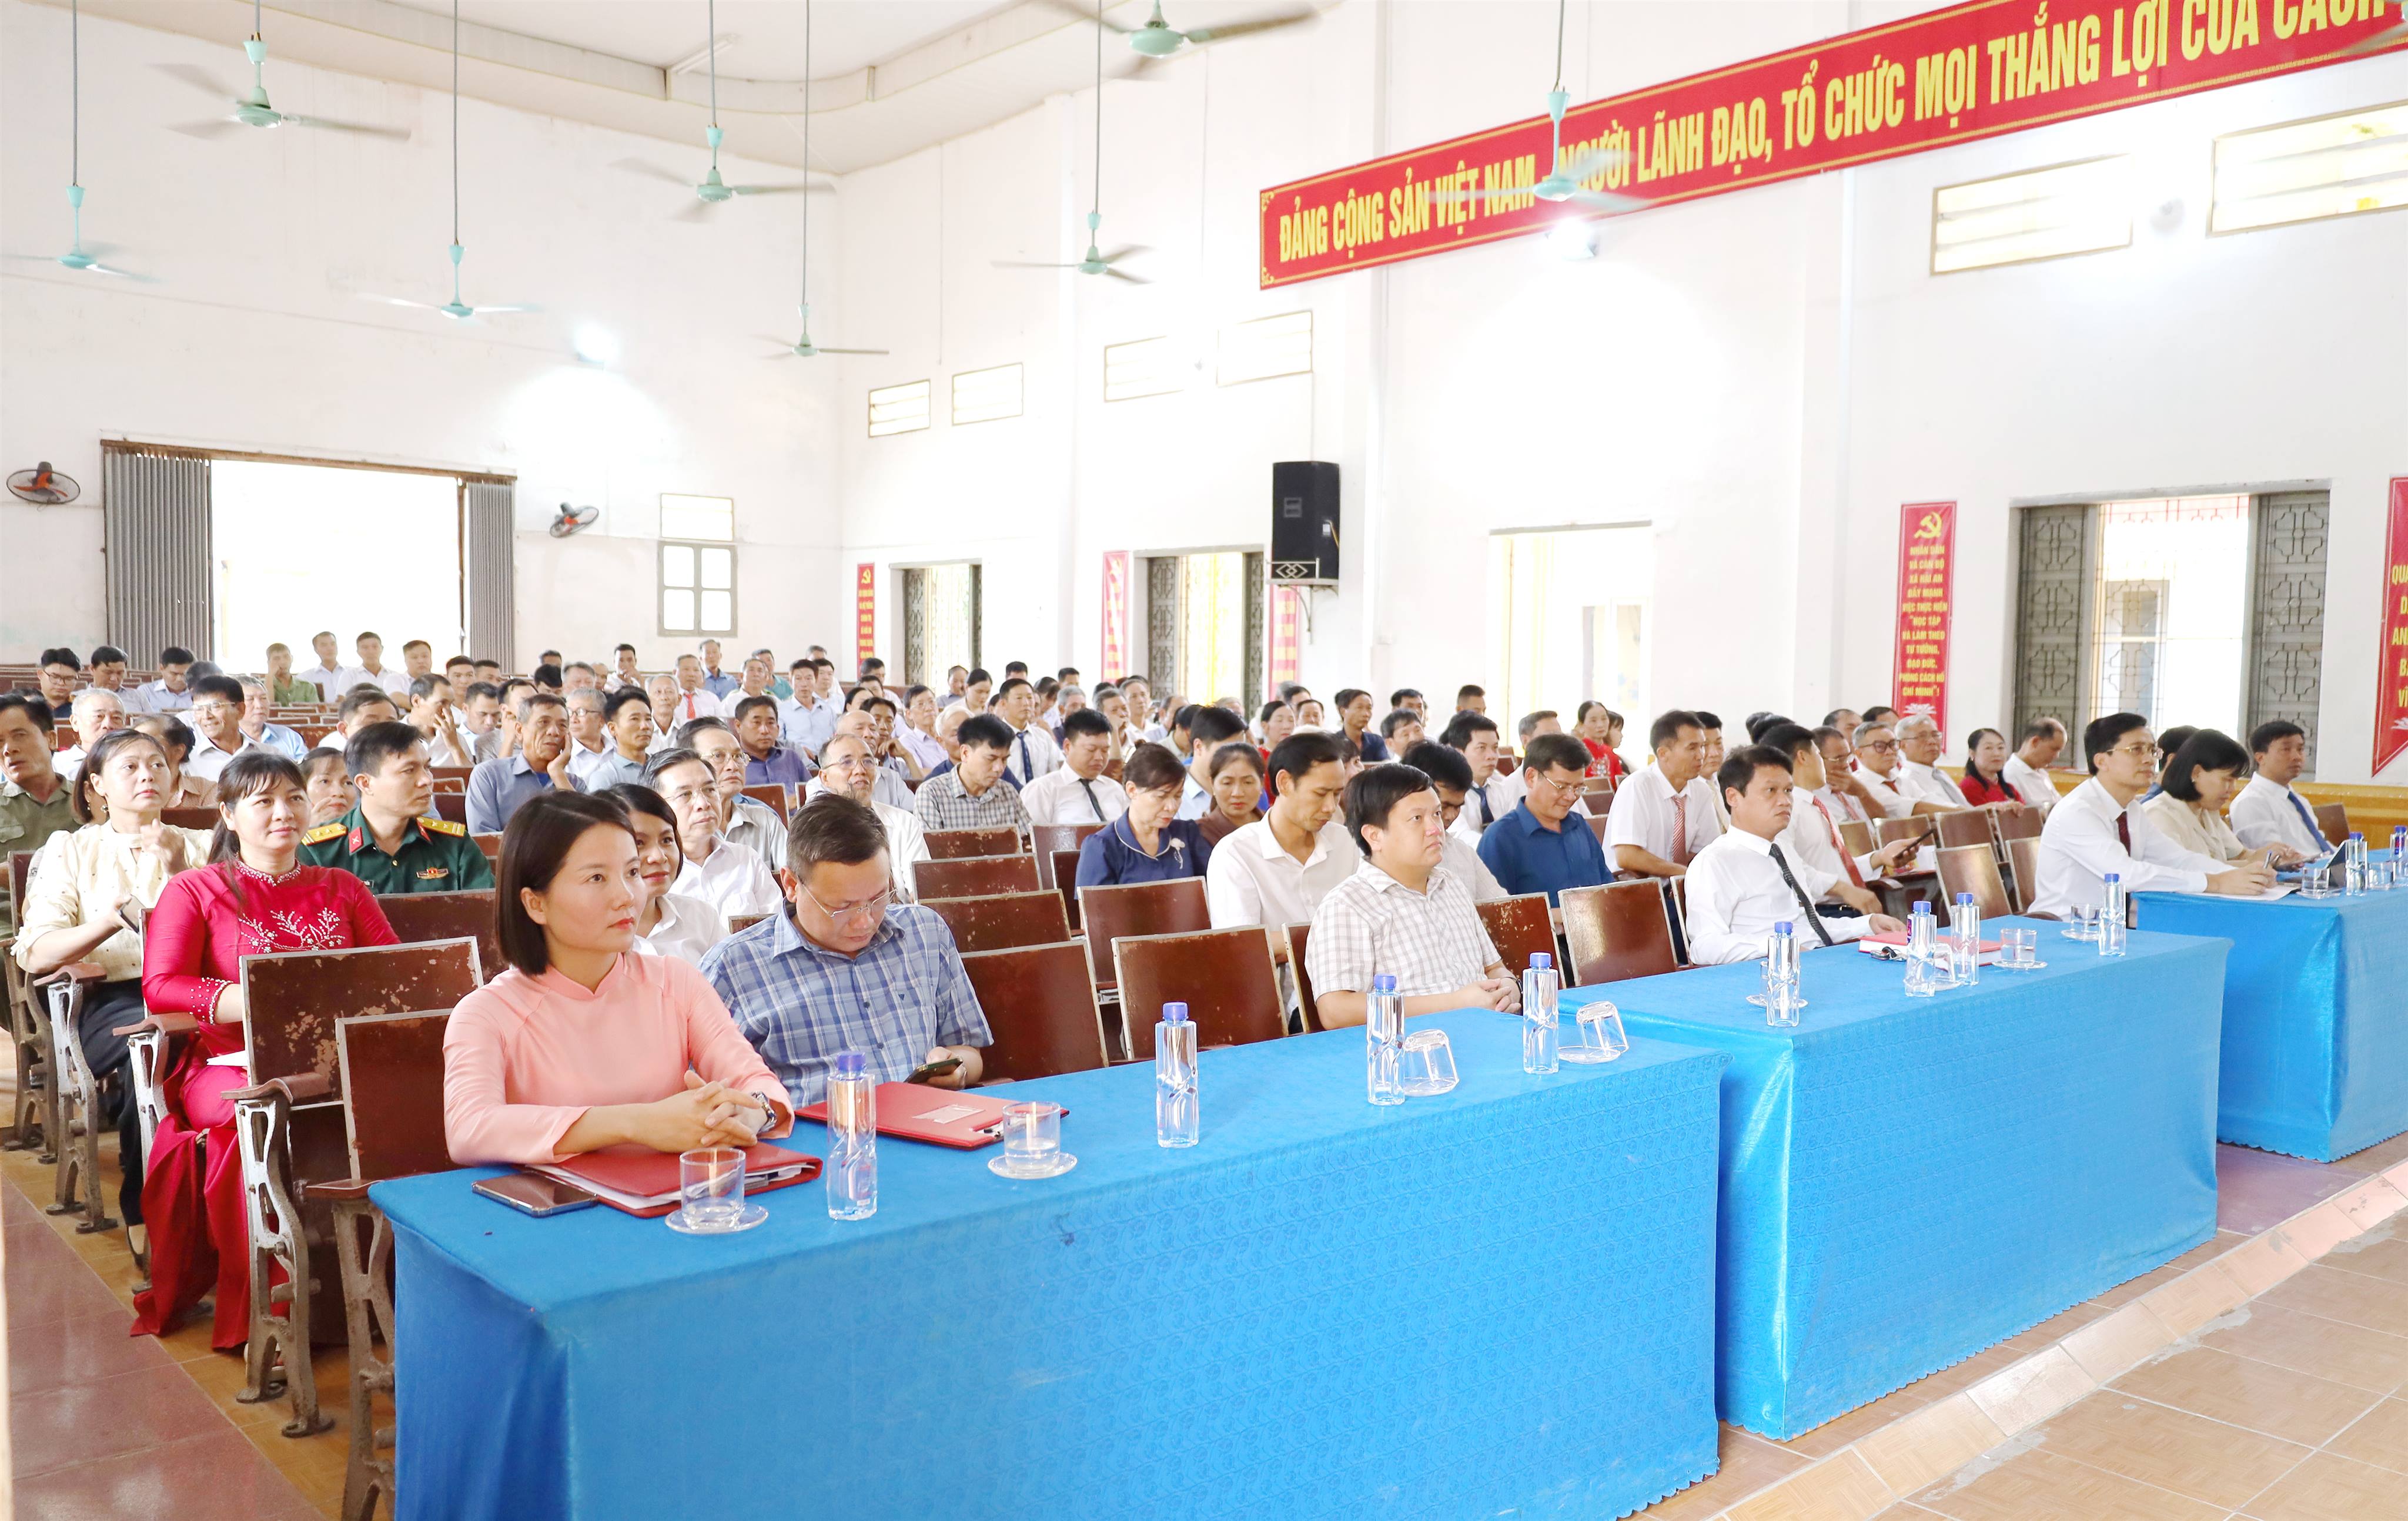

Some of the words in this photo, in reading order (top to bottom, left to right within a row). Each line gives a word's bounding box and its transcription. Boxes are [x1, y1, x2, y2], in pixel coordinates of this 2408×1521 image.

[1280, 196, 1328, 263] ĐẢNG
[1333, 188, 1384, 259] CỘNG
[1389, 167, 1430, 238] SẢN
[1435, 160, 1479, 234] VIỆT
[1484, 154, 1535, 217] NAM
[1637, 109, 1704, 183] LÃNH
[1711, 97, 1772, 175] ĐẠO,
[1781, 59, 1818, 150] TỔ
[1824, 54, 1905, 141] CHỨC
[1914, 44, 1977, 129] MỌI
[1987, 1, 2101, 105] THẮNG
[2112, 0, 2169, 88] LỢI
